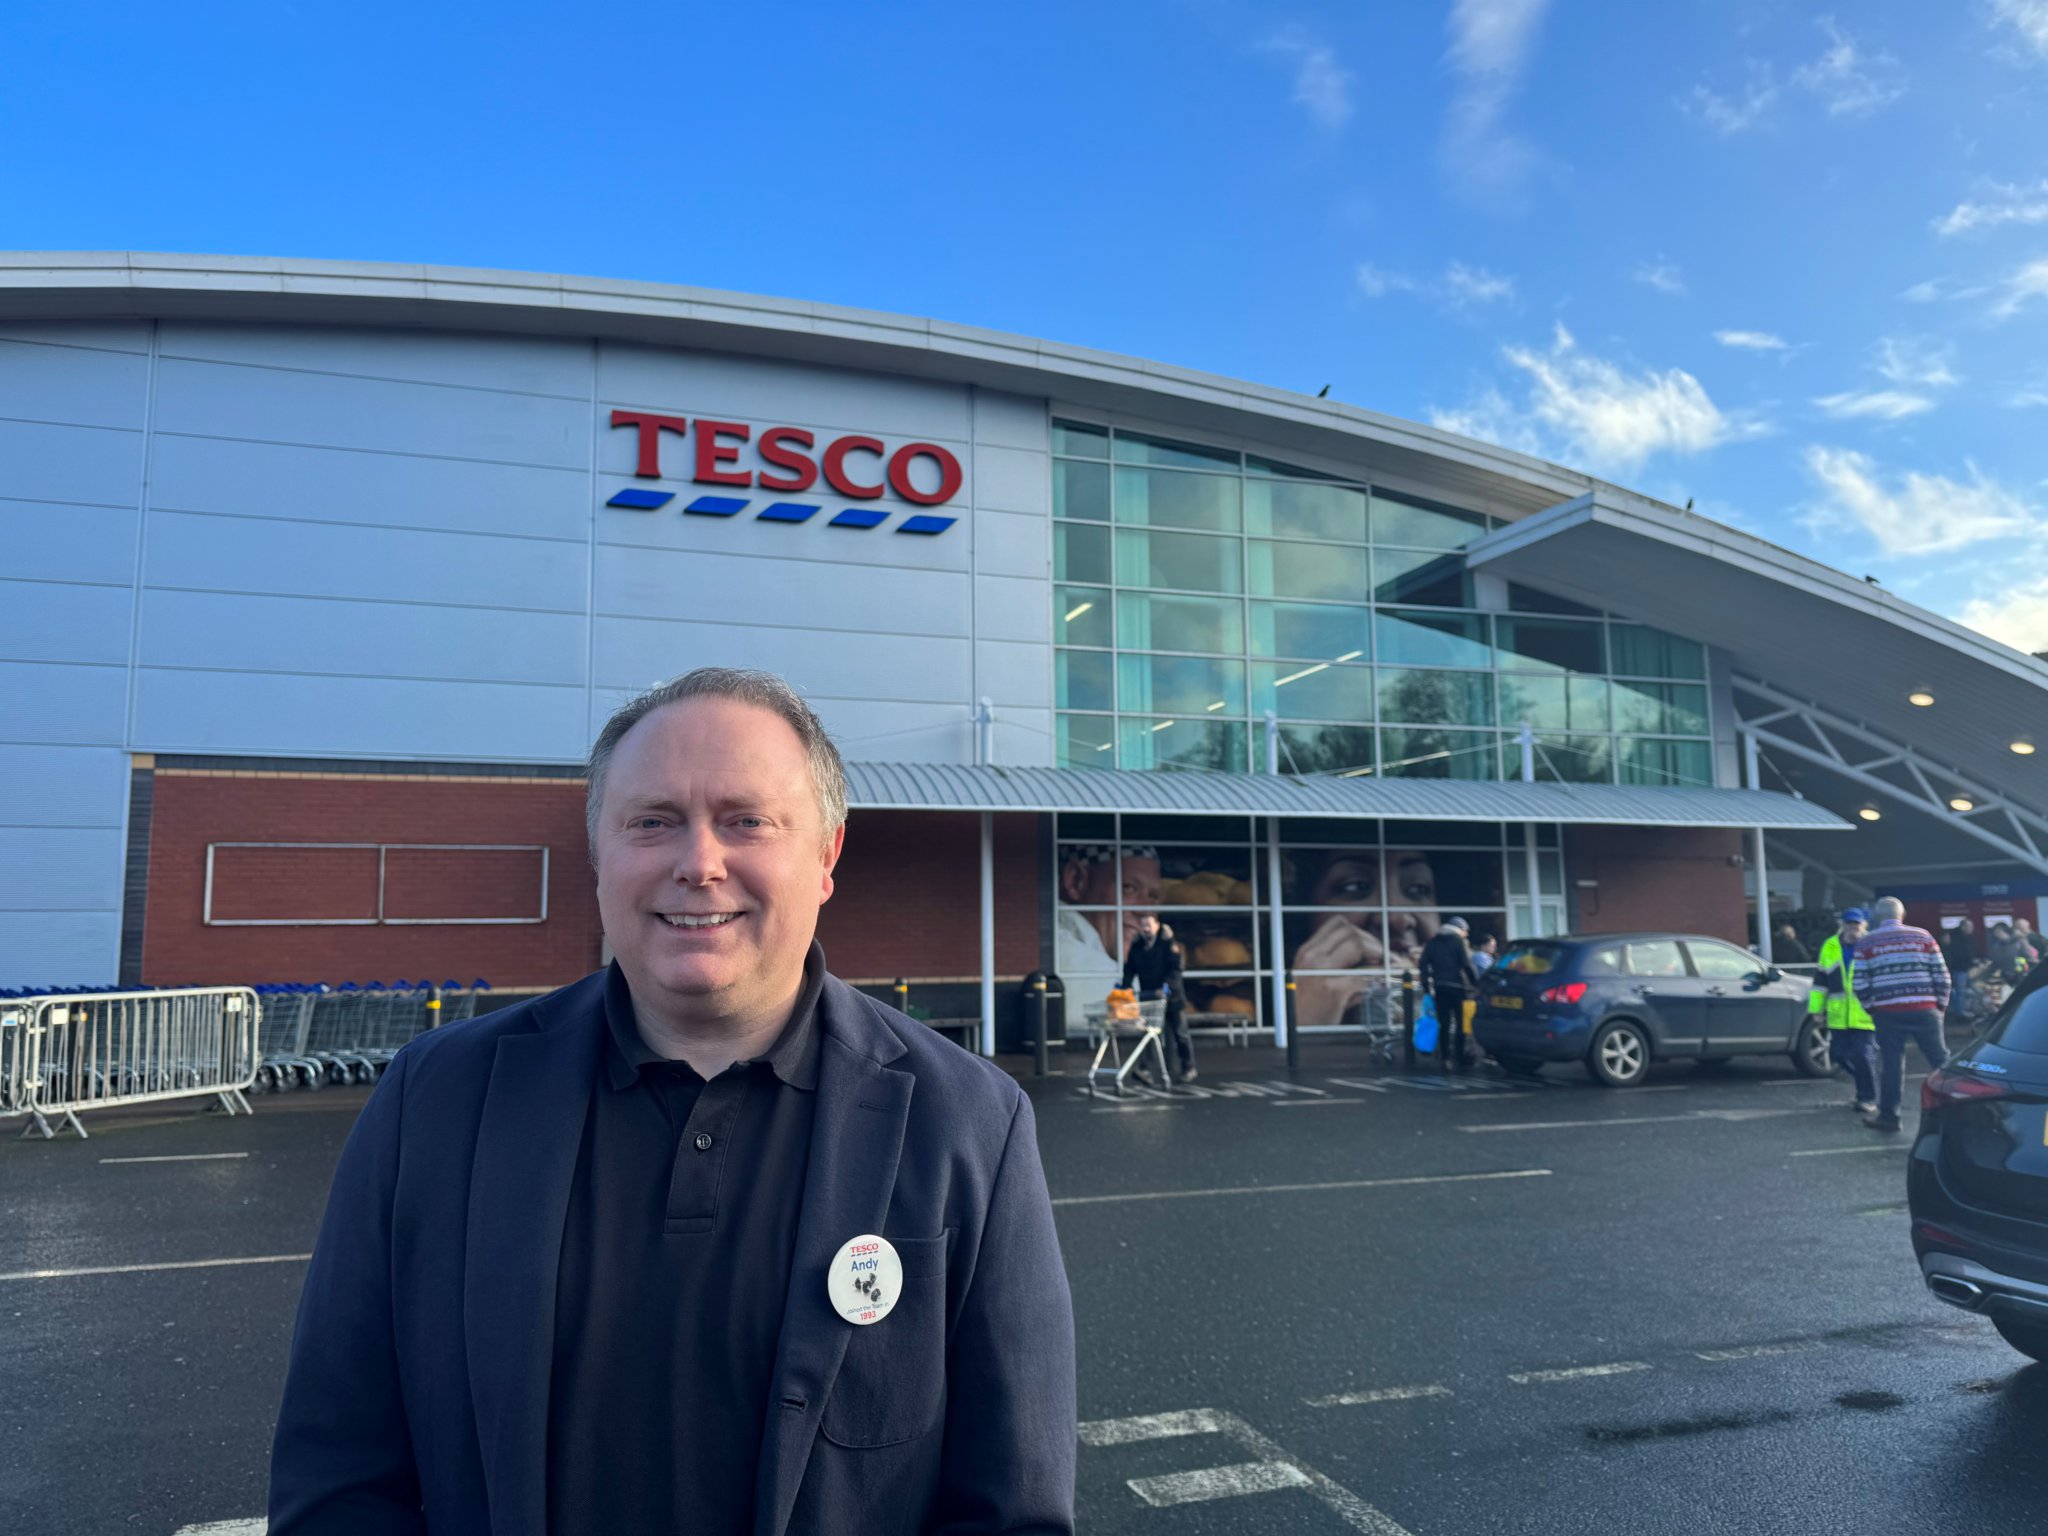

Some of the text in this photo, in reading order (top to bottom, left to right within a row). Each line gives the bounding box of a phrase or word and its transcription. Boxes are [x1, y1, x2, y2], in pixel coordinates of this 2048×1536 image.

[611, 409, 963, 507] TESCO
[849, 1243, 879, 1254] TESCO
[851, 1258, 879, 1272] Andy
[860, 1311, 876, 1320] 1993
